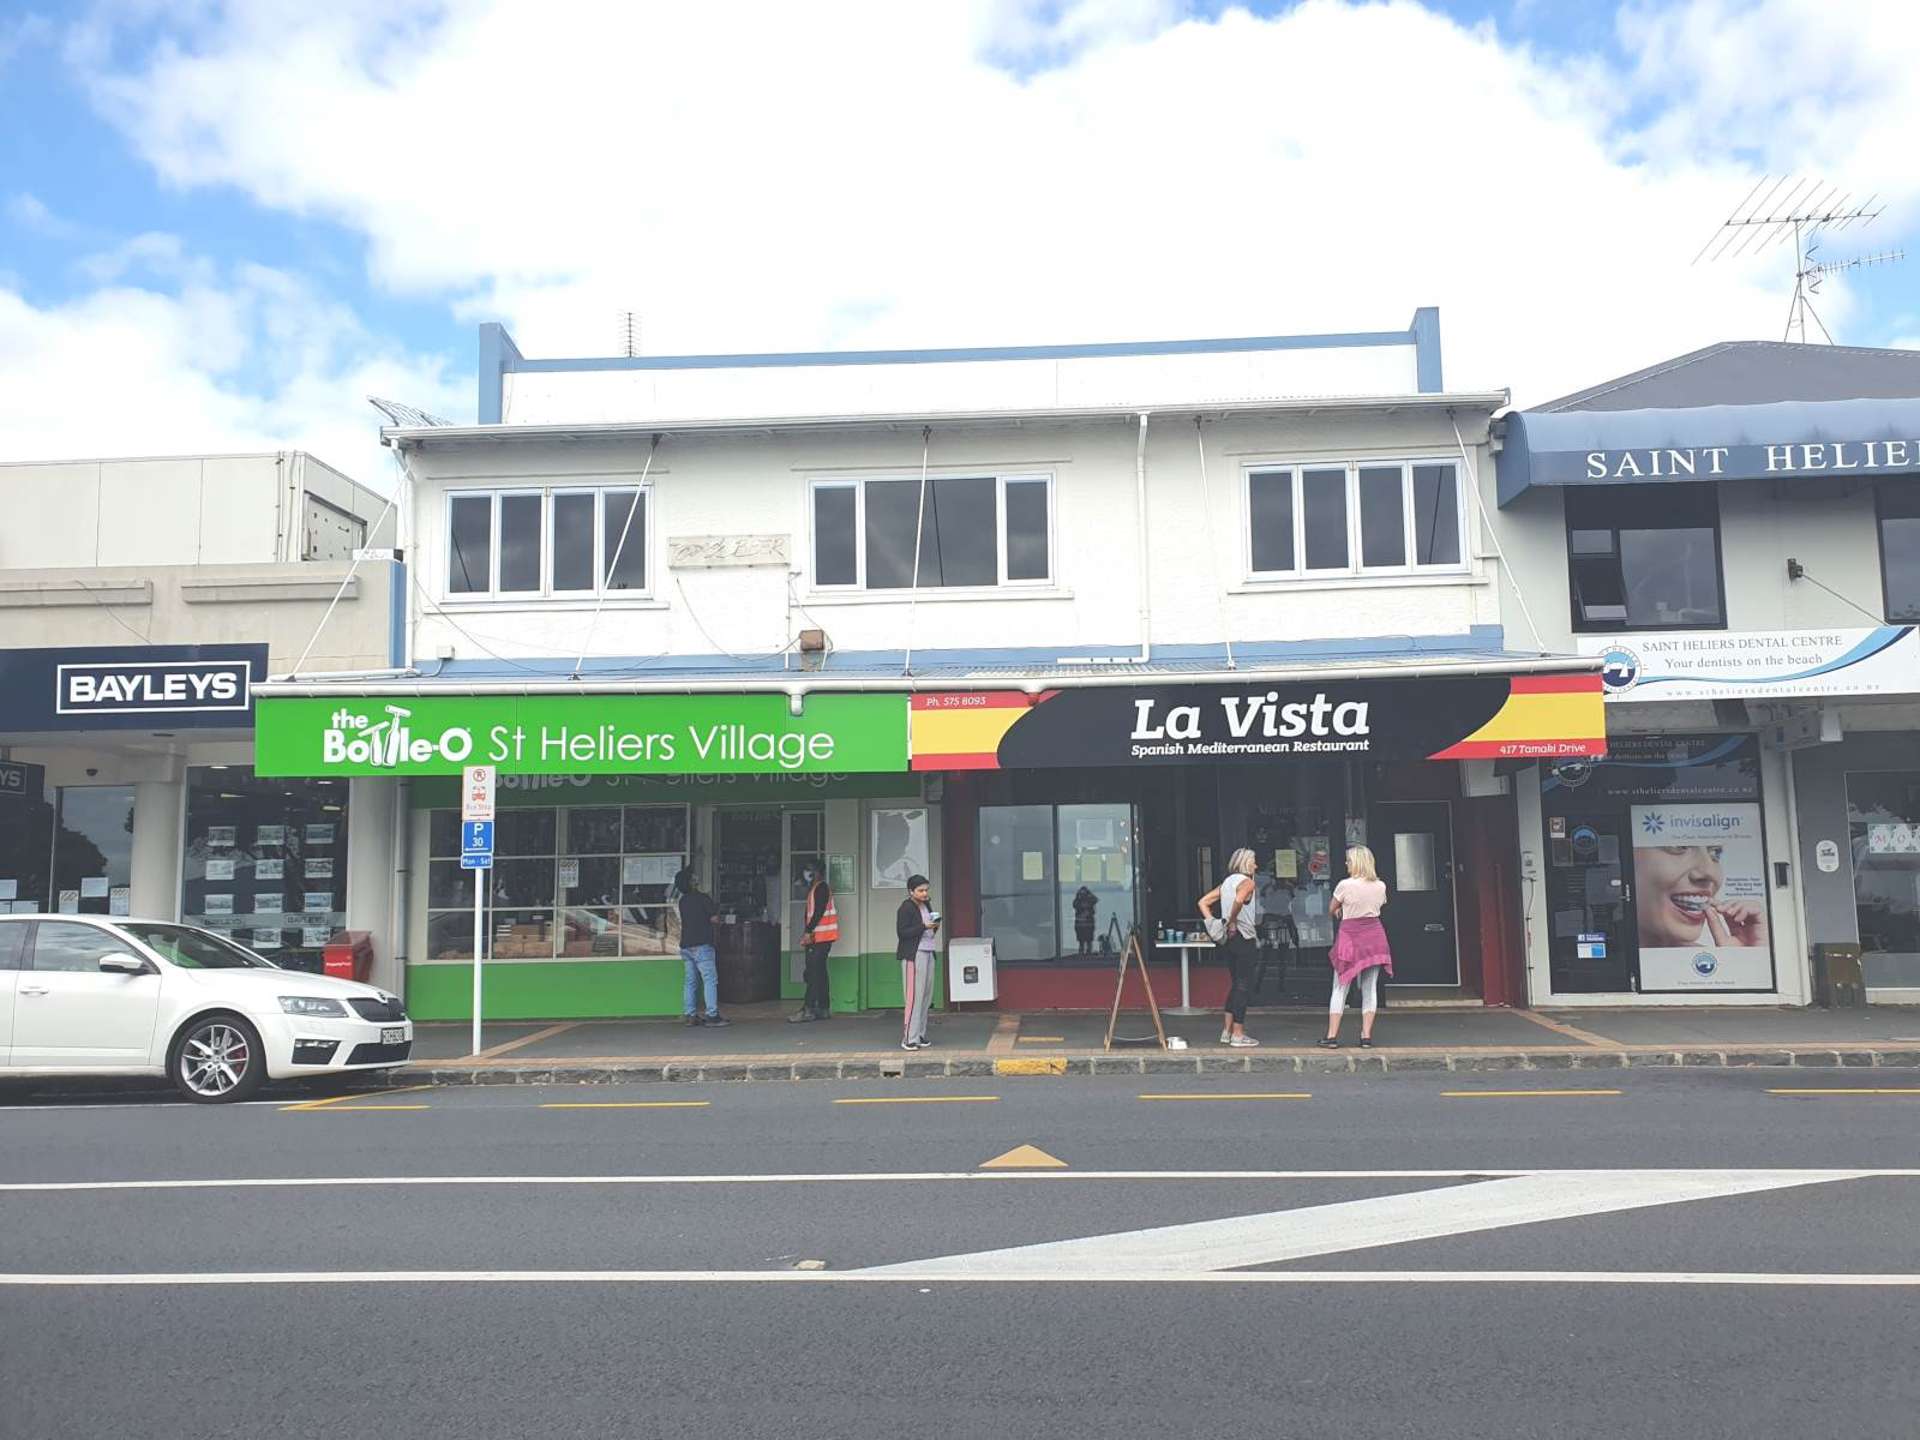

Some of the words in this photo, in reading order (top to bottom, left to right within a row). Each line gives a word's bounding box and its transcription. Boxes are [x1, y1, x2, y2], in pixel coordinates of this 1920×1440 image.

[1585, 447, 1729, 479] SAINT
[1764, 440, 1920, 472] HELIE
[1642, 641, 1679, 652] SAINT
[1683, 639, 1735, 651] HELIERS
[1738, 637, 1787, 649] DENTAL
[1791, 635, 1843, 647] CENTRE
[1664, 658, 1693, 669] Your
[1697, 656, 1743, 668] dentists
[1746, 658, 1761, 667] on
[1765, 655, 1783, 666] the
[1786, 654, 1823, 665] beach
[69, 672, 238, 703] BAYLEYS
[943, 696, 960, 706] 575
[961, 695, 986, 705] 8093
[331, 708, 369, 730] the
[1130, 698, 1202, 740] La
[1220, 691, 1371, 738] Vista
[323, 718, 473, 767] Bottle-O
[488, 725, 526, 762] St
[541, 725, 676, 762] Heliers
[688, 724, 835, 769] Village
[1131, 742, 1184, 758] Spanish
[1187, 741, 1290, 755] Mediterranean
[1293, 739, 1370, 752] Restaurant
[1499, 744, 1517, 754] 417
[1519, 743, 1556, 754] Tamaki
[1558, 743, 1586, 753] Drive
[474, 823, 484, 835] P
[1670, 814, 1740, 830] invisalign
[472, 837, 484, 847] 30
